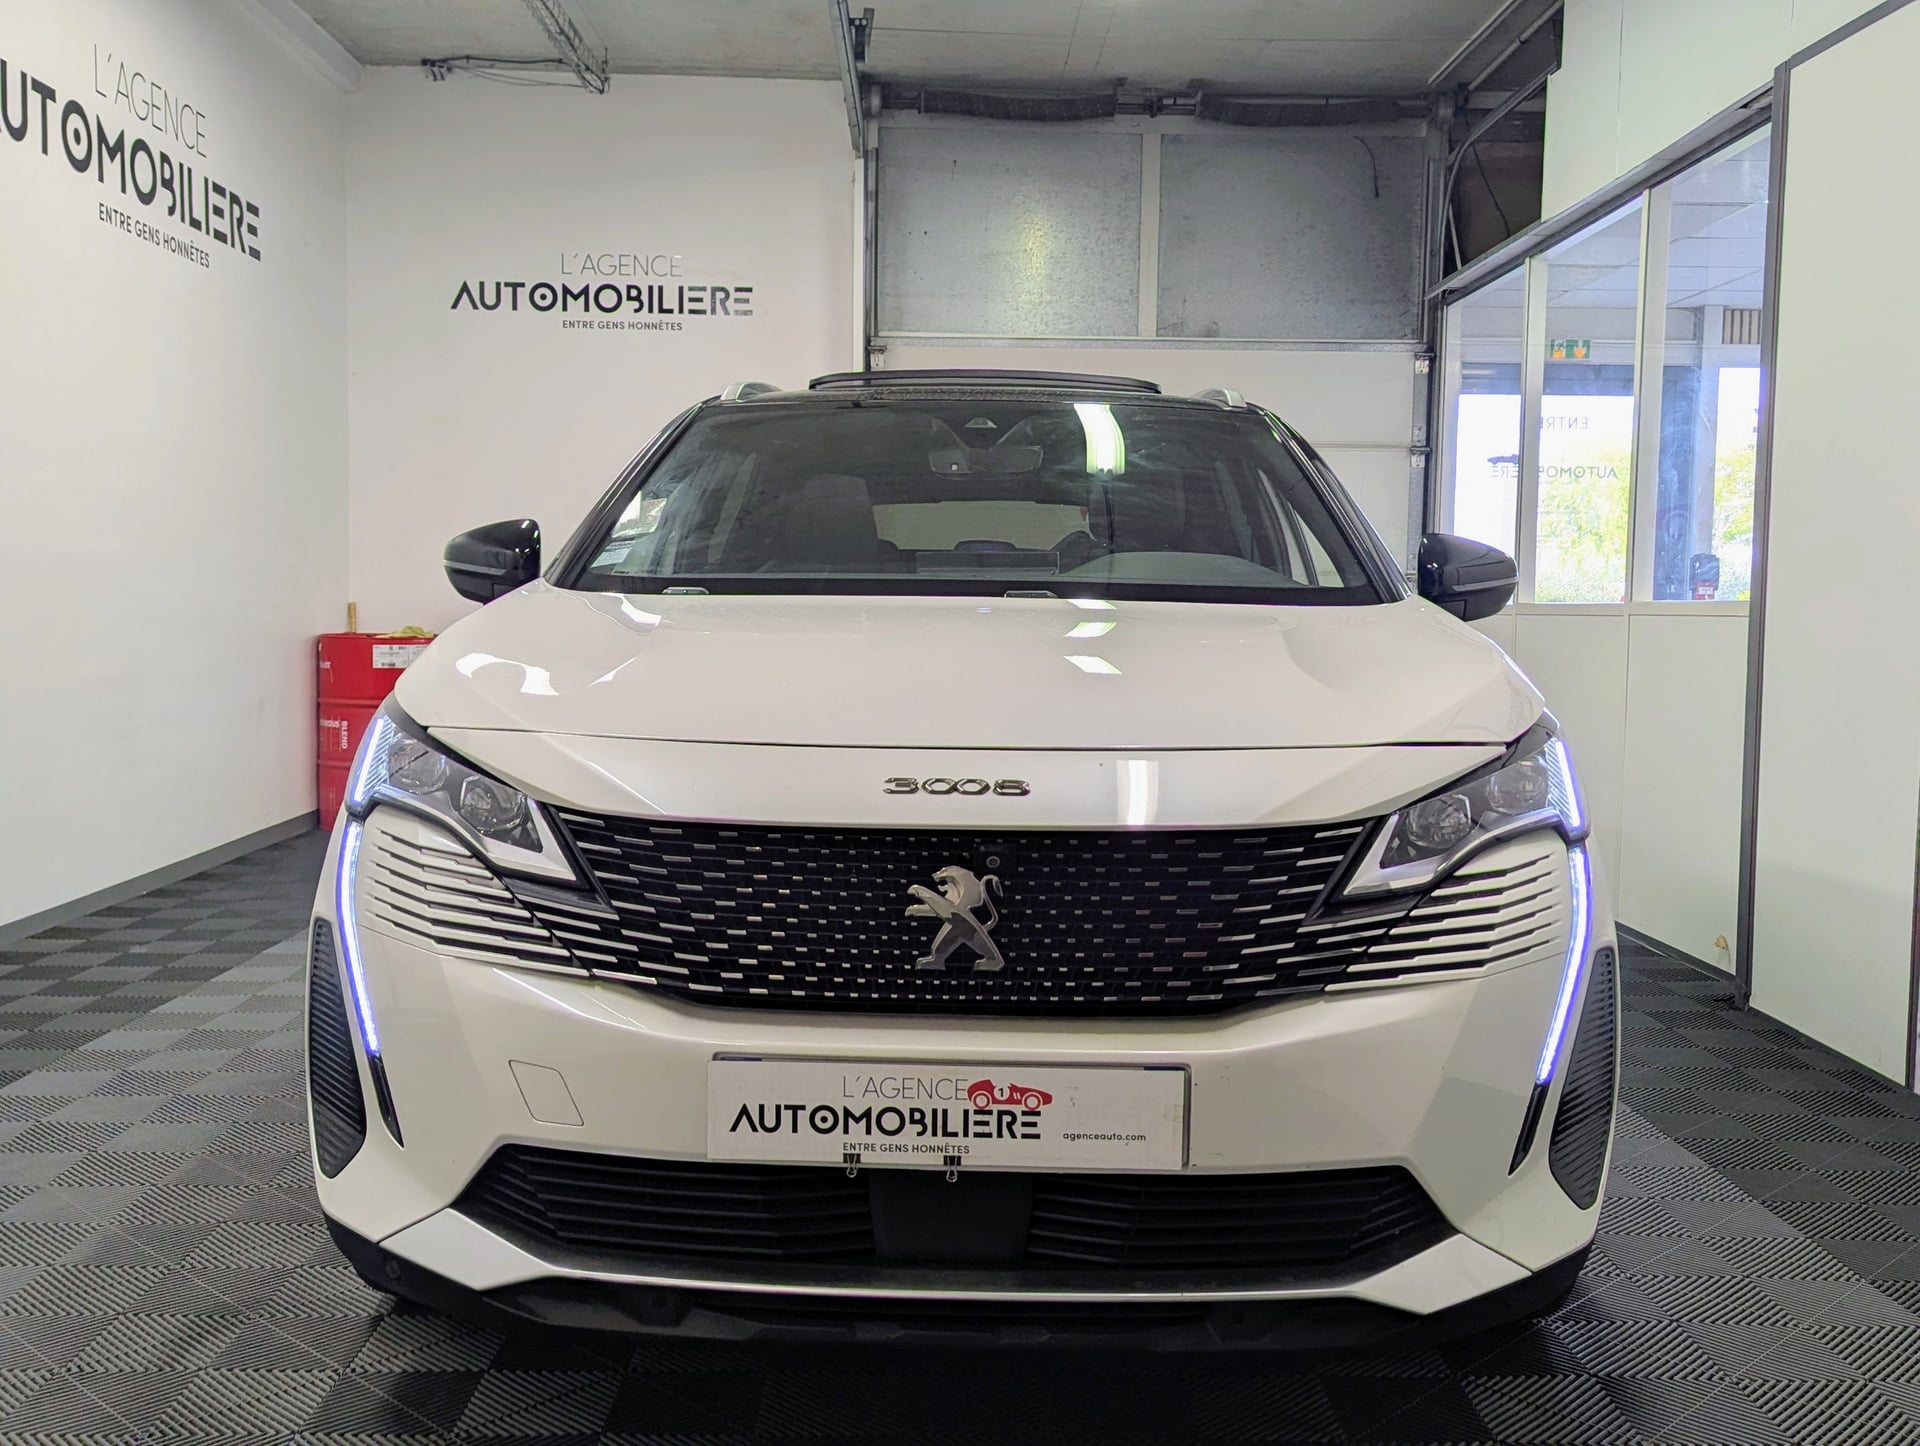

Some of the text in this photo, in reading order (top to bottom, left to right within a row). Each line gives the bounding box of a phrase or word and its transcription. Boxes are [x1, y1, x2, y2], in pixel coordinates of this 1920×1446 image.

[94, 43, 207, 158] L'AGENCE
[0, 57, 261, 262] UTOMOBILIERE
[98, 202, 210, 268] ENTRE GENS HONNÊTES
[561, 252, 683, 277] L'AGENCE
[450, 280, 753, 316] AUTOMOBILIERE
[562, 319, 683, 332] ENTRE GENS HONNÊTES
[883, 777, 1031, 797] 3008
[842, 1075, 969, 1101] L'AGENCE
[998, 1086, 1005, 1098] 1
[729, 1103, 1042, 1140] AUTOMOBILIERE
[843, 1142, 970, 1154] ENTRE GENS HONNÊTES
[1062, 1131, 1147, 1142] agenceauto.com
